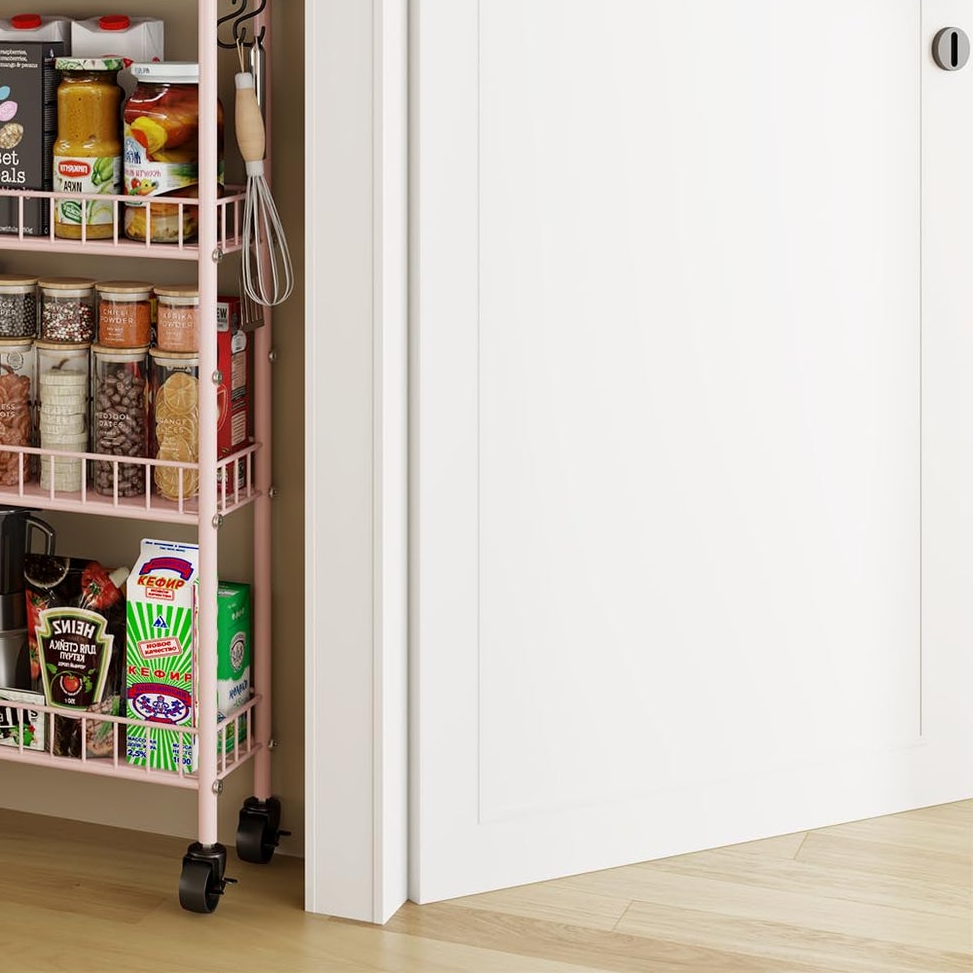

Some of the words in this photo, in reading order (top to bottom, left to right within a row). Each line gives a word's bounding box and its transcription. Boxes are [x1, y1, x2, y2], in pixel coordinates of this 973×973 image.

[217, 308, 228, 319] EW
[137, 576, 186, 590] КЕФИР
[145, 645, 177, 656] качество
[146, 641, 172, 650] новое
[128, 666, 192, 682] КЕФИР
[128, 736, 157, 745] МАССОАЯ
